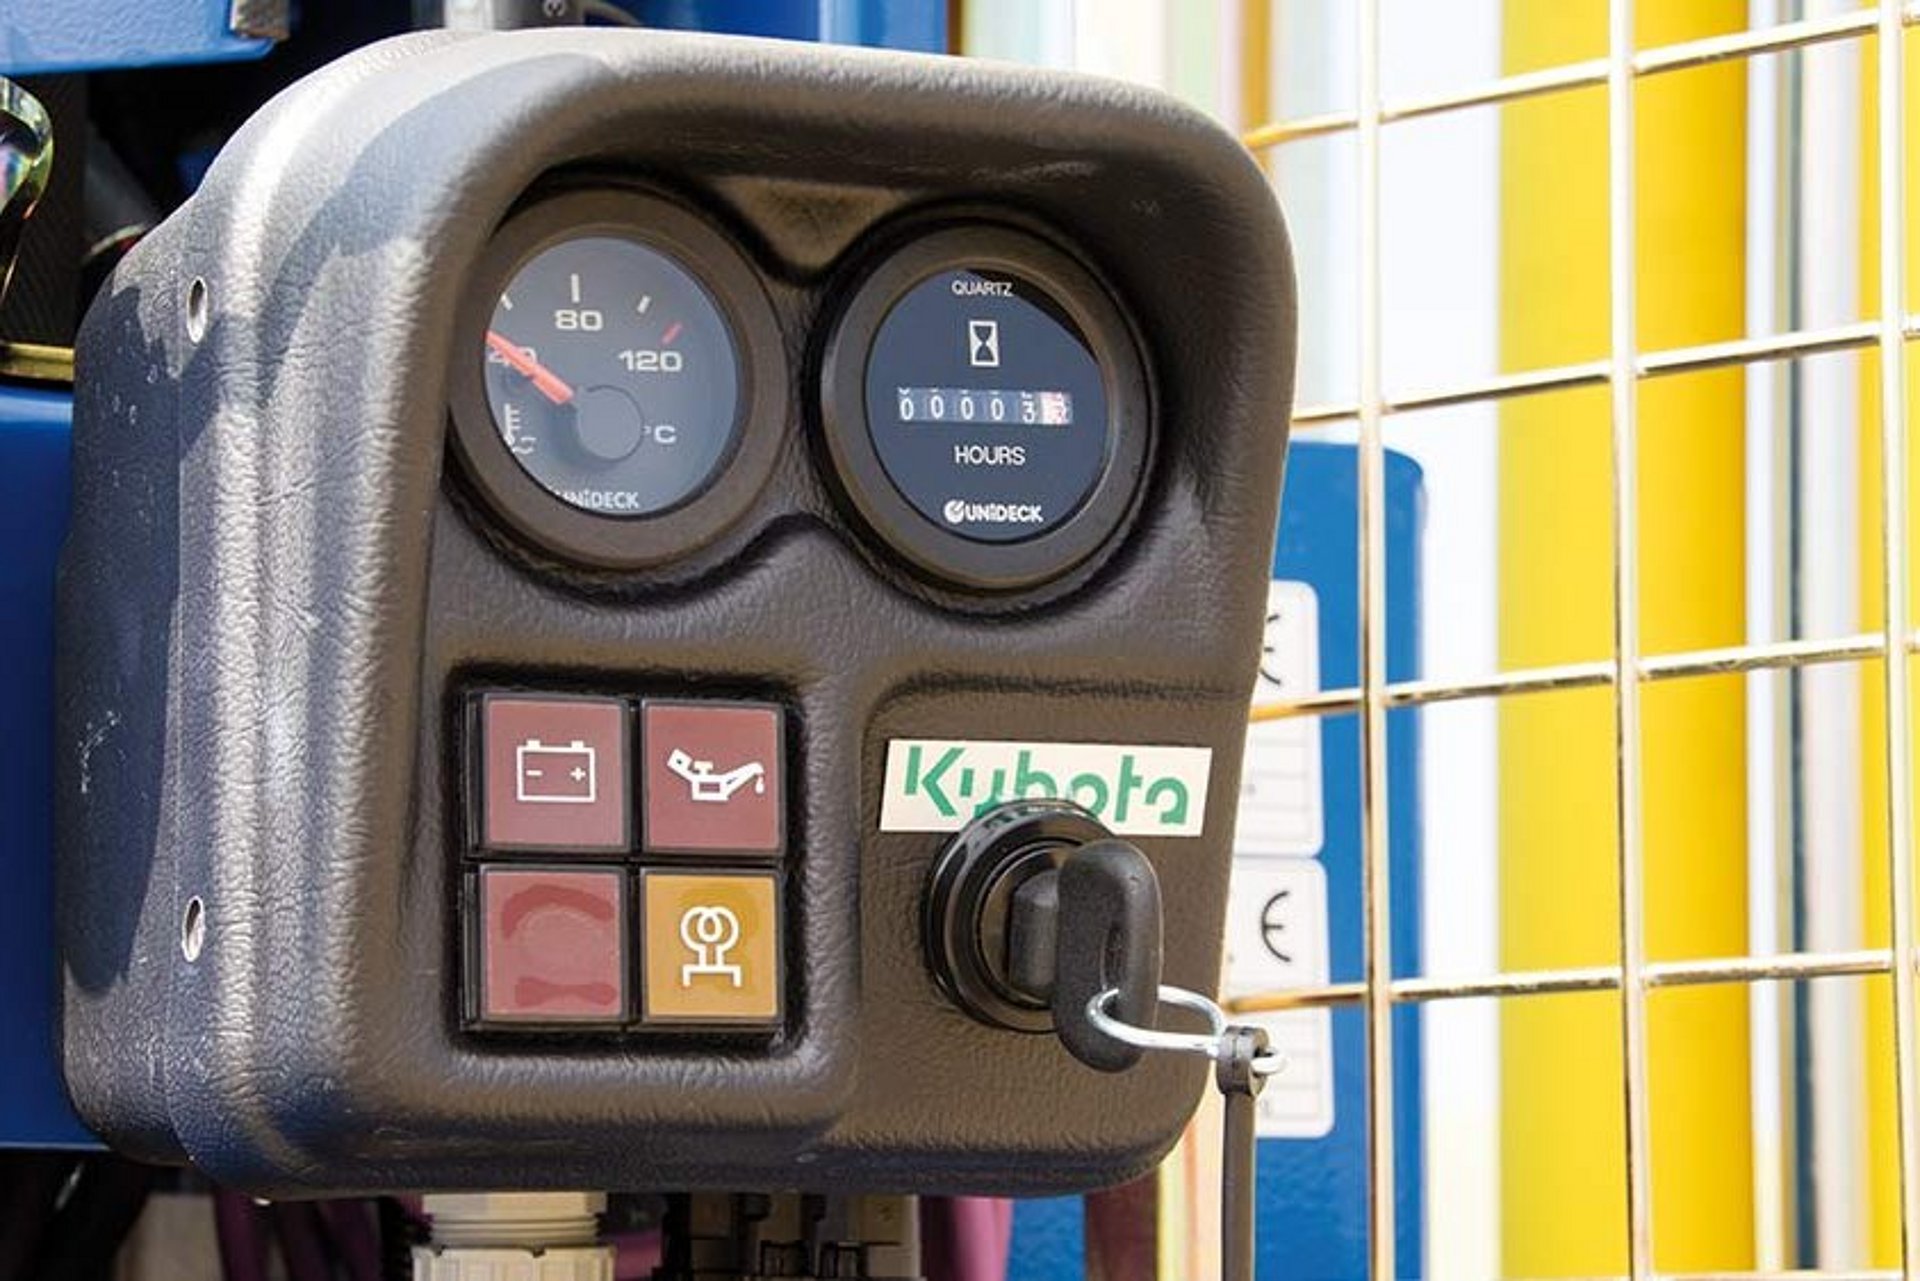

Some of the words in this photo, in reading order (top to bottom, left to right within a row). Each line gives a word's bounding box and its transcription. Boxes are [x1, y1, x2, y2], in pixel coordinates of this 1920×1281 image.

[951, 280, 1014, 297] QUARTZ
[554, 309, 603, 331] 80
[618, 350, 683, 372] 120
[954, 445, 1026, 466] HOURS
[903, 745, 1189, 824] Kubota
